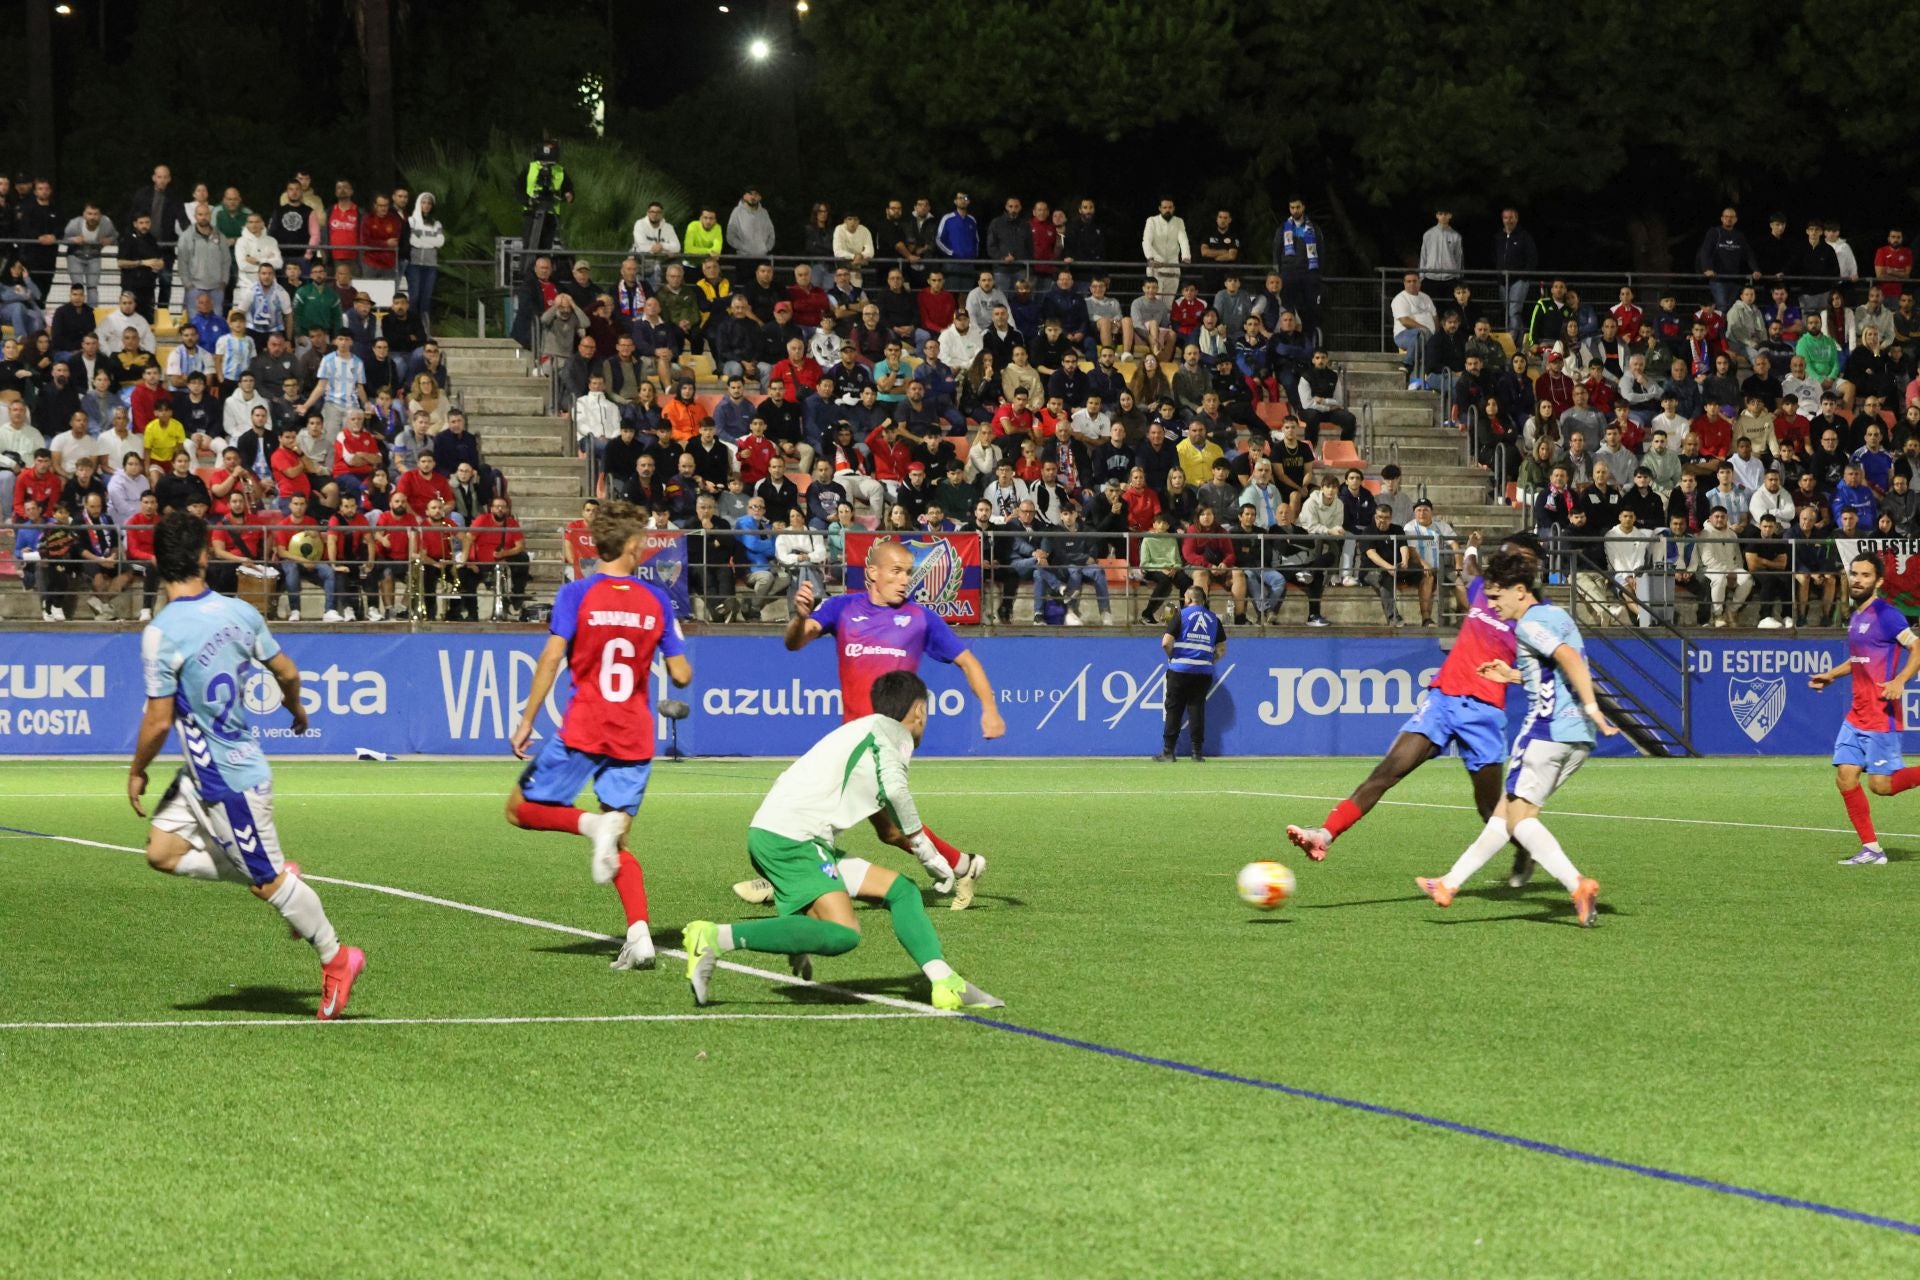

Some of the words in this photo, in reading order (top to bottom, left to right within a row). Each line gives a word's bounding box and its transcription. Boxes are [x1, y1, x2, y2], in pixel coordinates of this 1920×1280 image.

[1881, 539, 1920, 554] ESTE
[599, 638, 635, 702] 6
[1722, 650, 1833, 673] ESTEPONA
[0, 665, 105, 699] UKI
[702, 679, 965, 716] azulmo
[992, 688, 1064, 703] RUPO
[17, 708, 91, 735] COSTA
[251, 725, 261, 738] &
